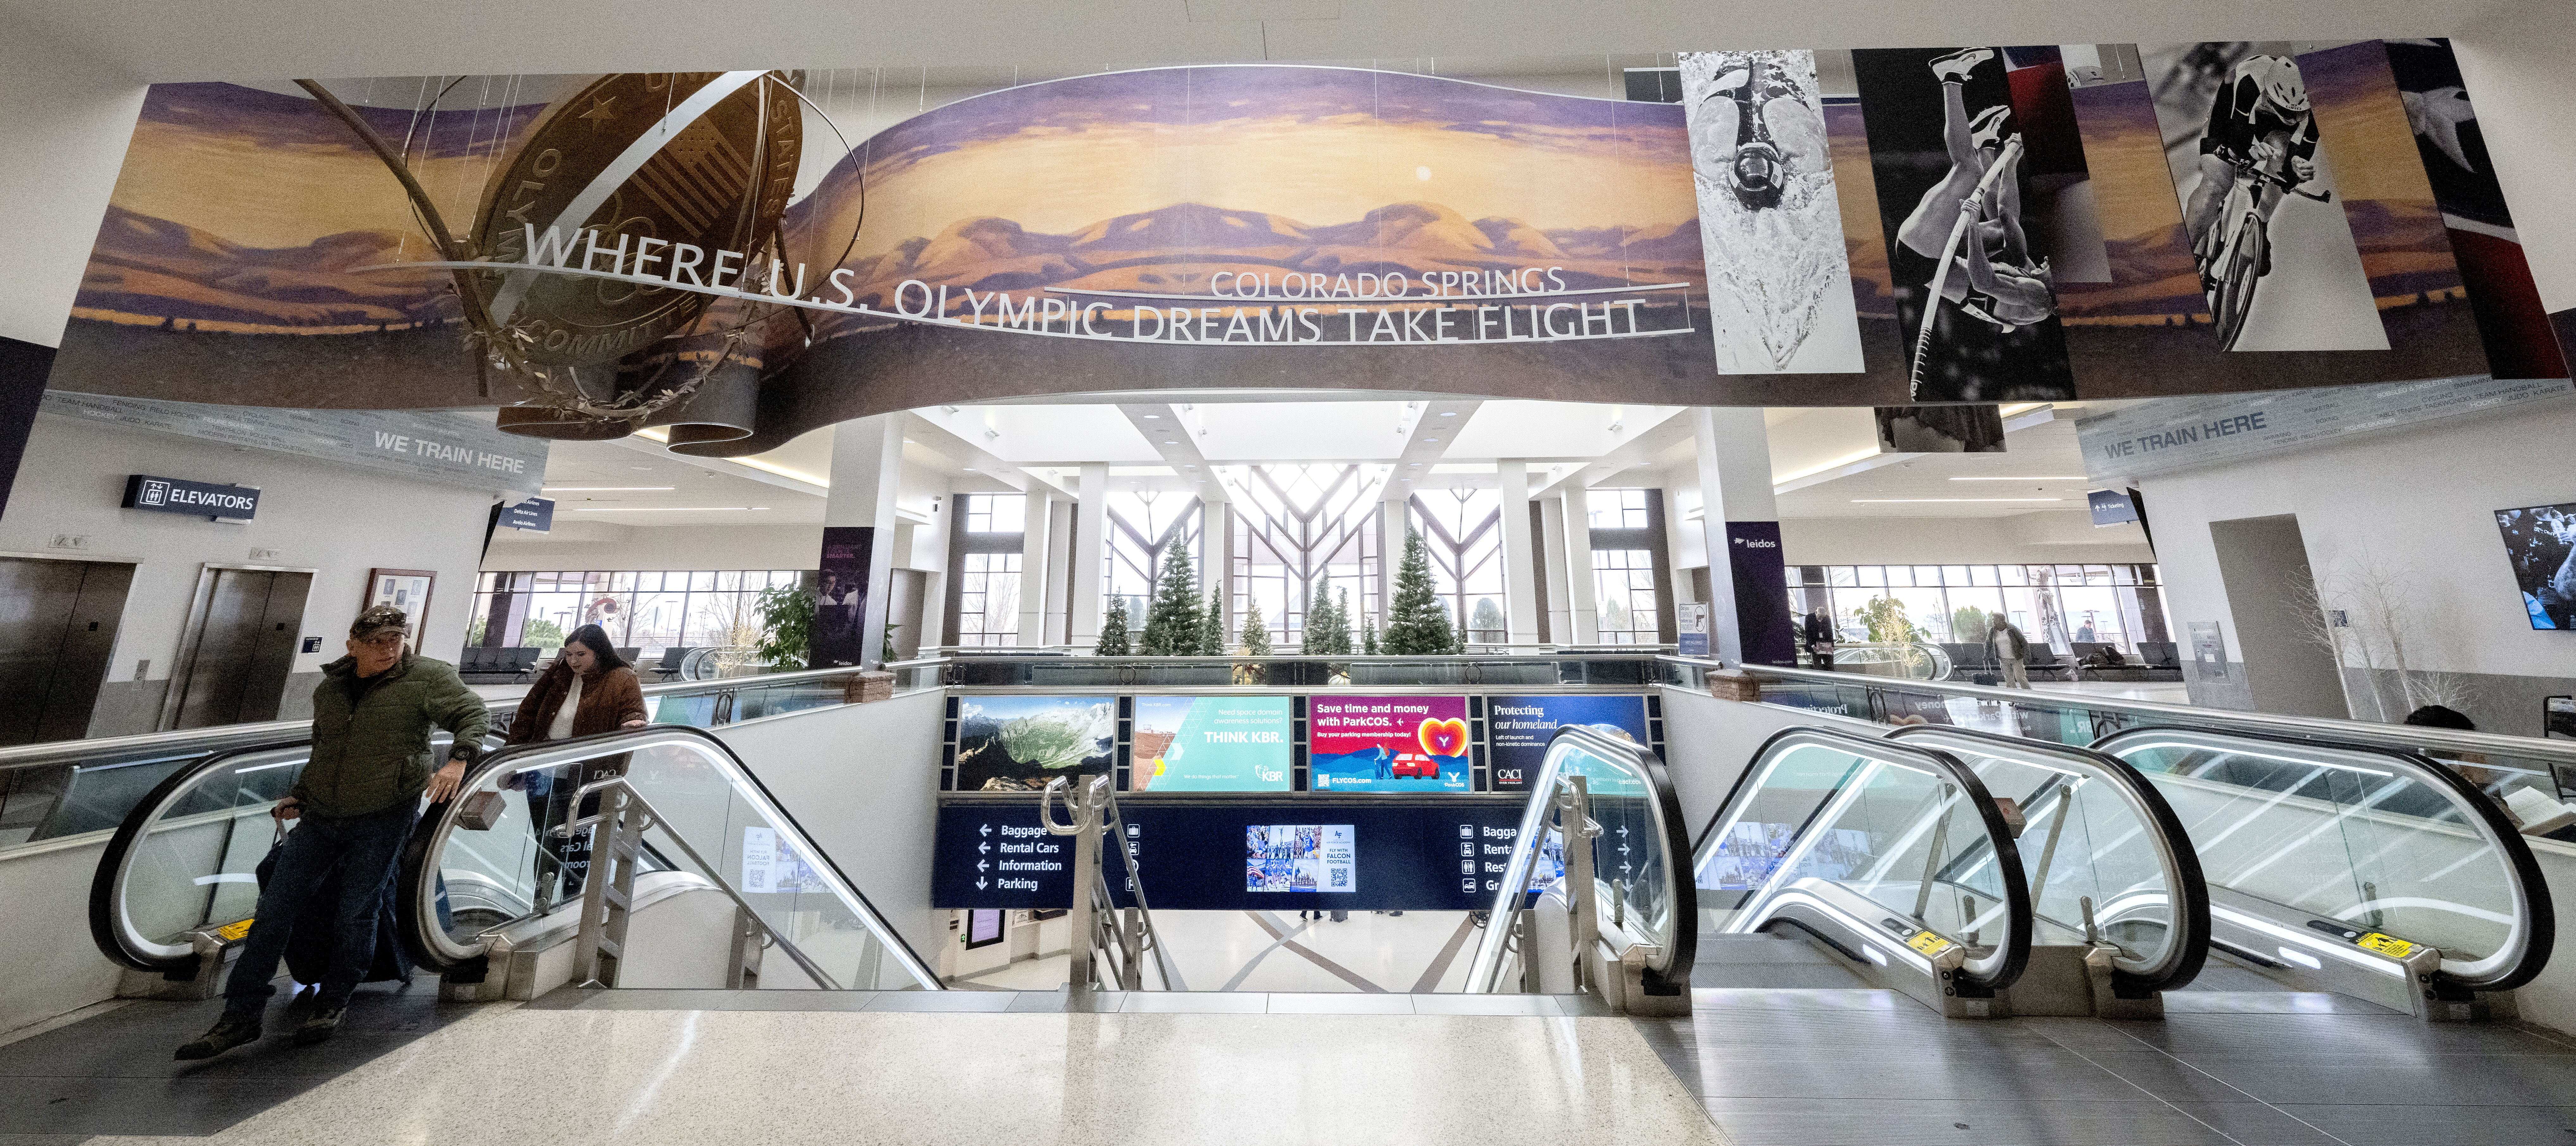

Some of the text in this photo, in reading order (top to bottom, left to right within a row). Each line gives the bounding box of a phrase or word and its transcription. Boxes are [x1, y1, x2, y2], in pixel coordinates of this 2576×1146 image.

[762, 99, 795, 219] STATES
[525, 223, 1646, 343] WHERE U.S. OLYMPIC DREAMS TAKE FLIGHT
[1212, 267, 1566, 299] COLORADO SPRINGS
[2415, 379, 2453, 390] SKELETON
[2454, 376, 2493, 389] SWIMMING
[2397, 405, 2422, 414] TENNIS
[2425, 396, 2472, 409] TAEKWONDO
[2475, 391, 2497, 400] TEAM
[2498, 382, 2543, 395] HANDBALL
[2422, 391, 2453, 403] CYCLING
[2470, 384, 2567, 408] HOCKEY JUDO KARATE
[57, 396, 80, 406] TEAM
[82, 401, 123, 413] HANDBALL
[113, 399, 146, 411] FENCING
[149, 406, 170, 415] FIELD
[171, 410, 199, 420] HOCKEY
[2304, 403, 2341, 414] BASKETBALL
[83, 409, 173, 429] HOCKEY JUDO KARATE
[2316, 415, 2339, 424] BOXING
[2104, 443, 2135, 459] WE
[2137, 425, 2198, 452] TRAIN
[2203, 411, 2267, 440] HERE
[2316, 428, 2341, 437] HOCKEY
[271, 442, 312, 454] RACQUETBALL
[375, 430, 525, 474] WE TRAIN HERE
[170, 489, 254, 510] ELEVATORS
[1747, 539, 1776, 548] leidos
[1317, 704, 1429, 714] Save time and money
[1494, 705, 1544, 717] Protecting
[1317, 717, 1392, 726] with ParkCOS.
[1495, 719, 1557, 729] our homeland
[1204, 731, 1284, 743] THINK KBR.
[1262, 771, 1283, 781] KBR
[1498, 769, 1522, 779] CACI
[1001, 825, 1047, 838] Baggage
[1483, 826, 1517, 840] Bagga
[1000, 842, 1059, 853] Rental Cars
[999, 860, 1062, 871] Information
[998, 877, 1038, 891] Parking
